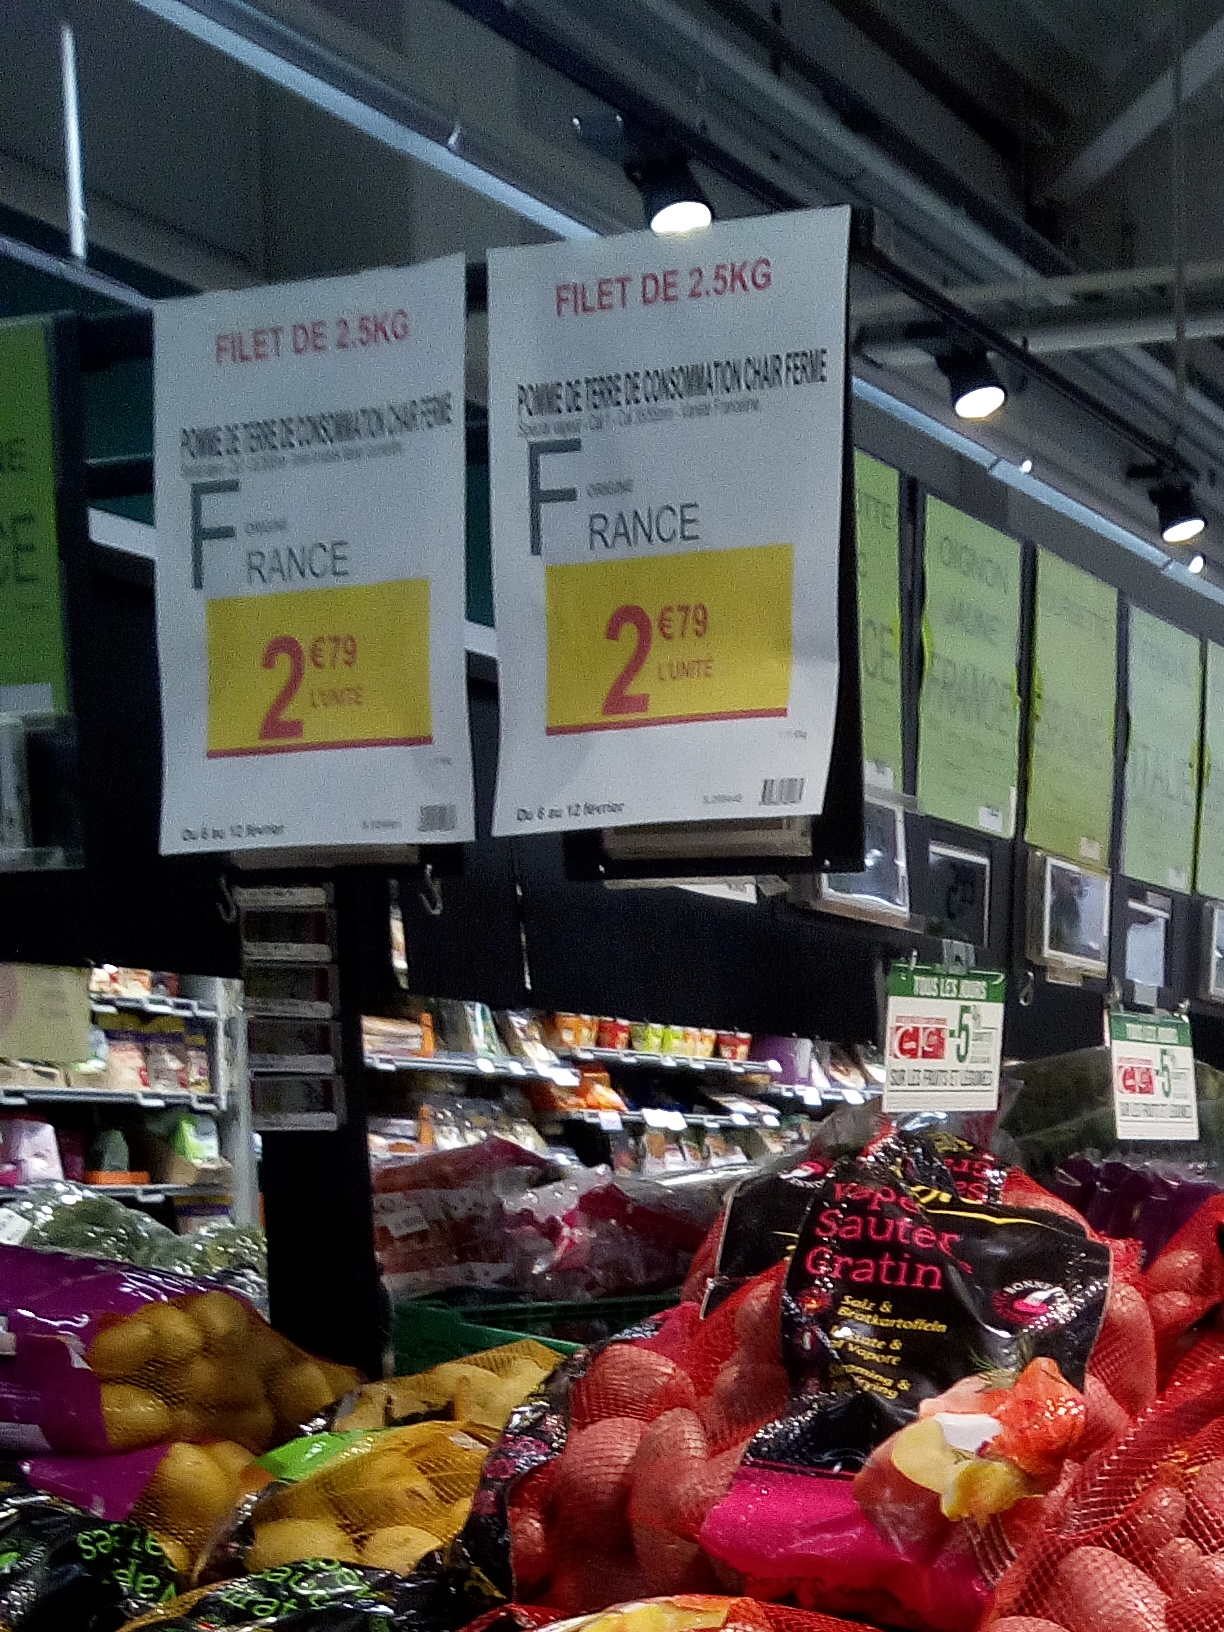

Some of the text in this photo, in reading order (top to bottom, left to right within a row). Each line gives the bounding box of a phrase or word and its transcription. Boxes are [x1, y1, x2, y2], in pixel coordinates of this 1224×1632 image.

[555, 257, 773, 317] FILET DE 2.5KG
[215, 308, 410, 365] FILET DE 2.5KG
[805, 1246, 943, 1291] Gratin
